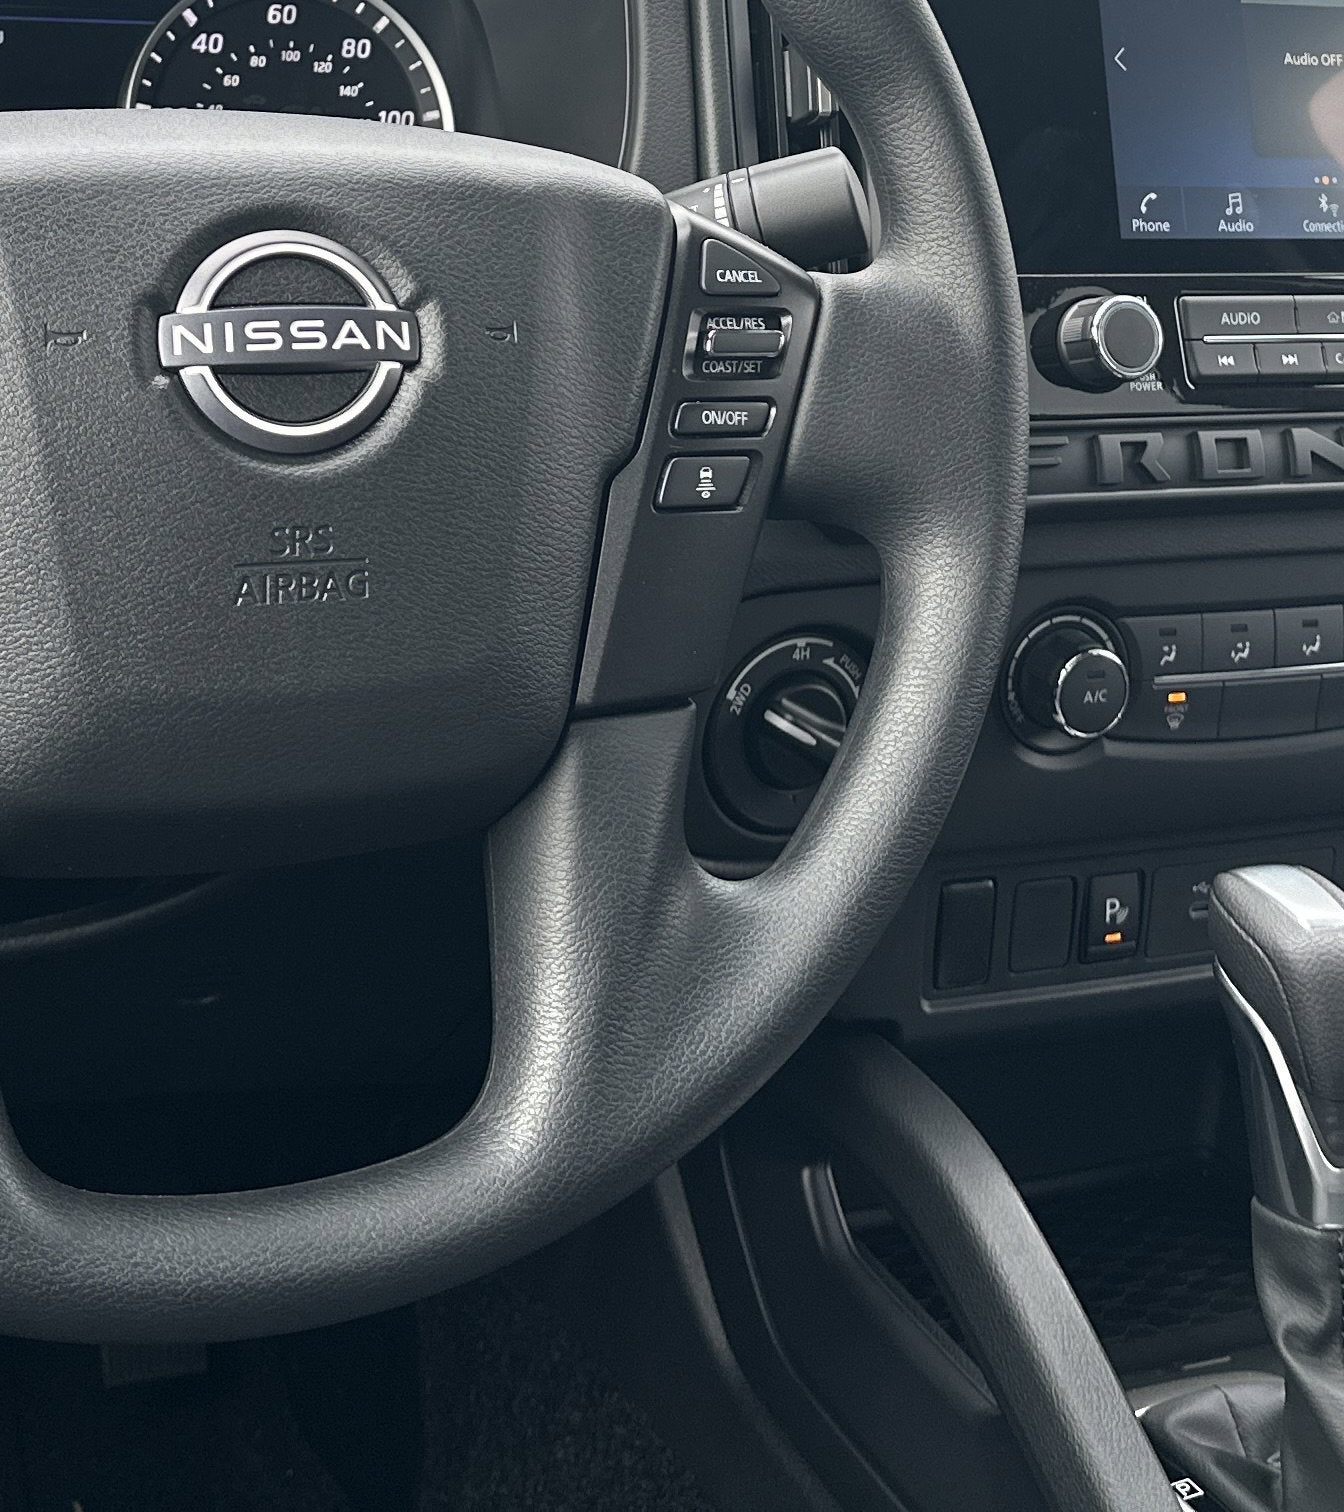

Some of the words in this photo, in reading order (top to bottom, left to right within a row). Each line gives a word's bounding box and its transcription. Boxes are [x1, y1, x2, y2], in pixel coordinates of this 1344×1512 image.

[266, 3, 297, 25] 60
[191, 33, 224, 54] 40
[341, 38, 371, 59] 80
[249, 55, 266, 67] 80
[280, 50, 301, 62] 100
[1283, 51, 1319, 67] Audio
[1320, 52, 1344, 67] OFF
[313, 61, 333, 73] 120
[223, 74, 240, 87] 60
[339, 85, 359, 97] 140
[377, 110, 415, 126] 100
[1131, 218, 1171, 233] Phone
[1217, 218, 1255, 234] Audio
[715, 269, 763, 283] CANCEL
[706, 317, 766, 330] ACCEL/RES
[1220, 312, 1261, 326] AUDIO
[171, 318, 413, 356] NISSAN
[701, 360, 764, 373] COAST/SET
[1129, 381, 1164, 392] POWER
[701, 410, 749, 426] ON/OFF
[268, 525, 335, 555] SRS
[236, 570, 370, 606] AIRBAG
[792, 647, 811, 661] 4H
[729, 683, 752, 717] 2WD
[1083, 690, 1107, 704] A/C
